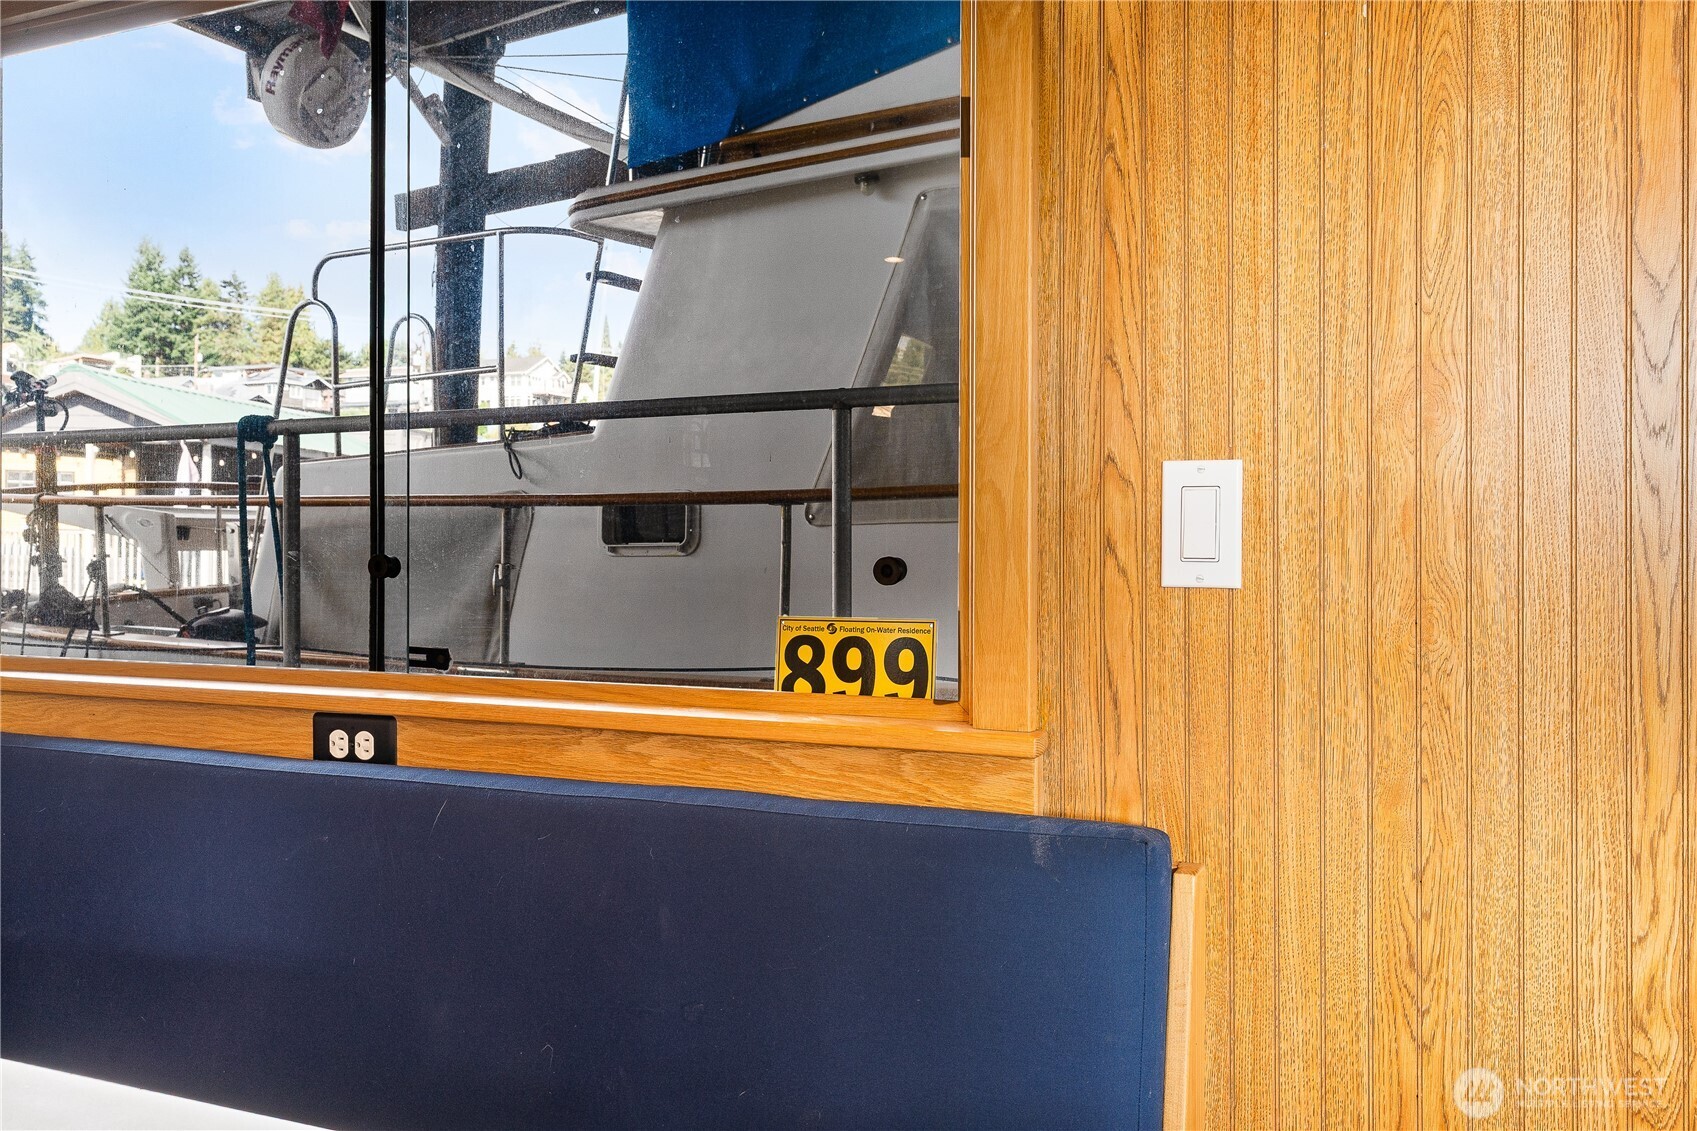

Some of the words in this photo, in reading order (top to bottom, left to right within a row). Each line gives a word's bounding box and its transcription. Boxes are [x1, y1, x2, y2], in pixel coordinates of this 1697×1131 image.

[782, 624, 795, 632] City
[839, 625, 865, 634] Floating
[781, 634, 929, 699] 899
